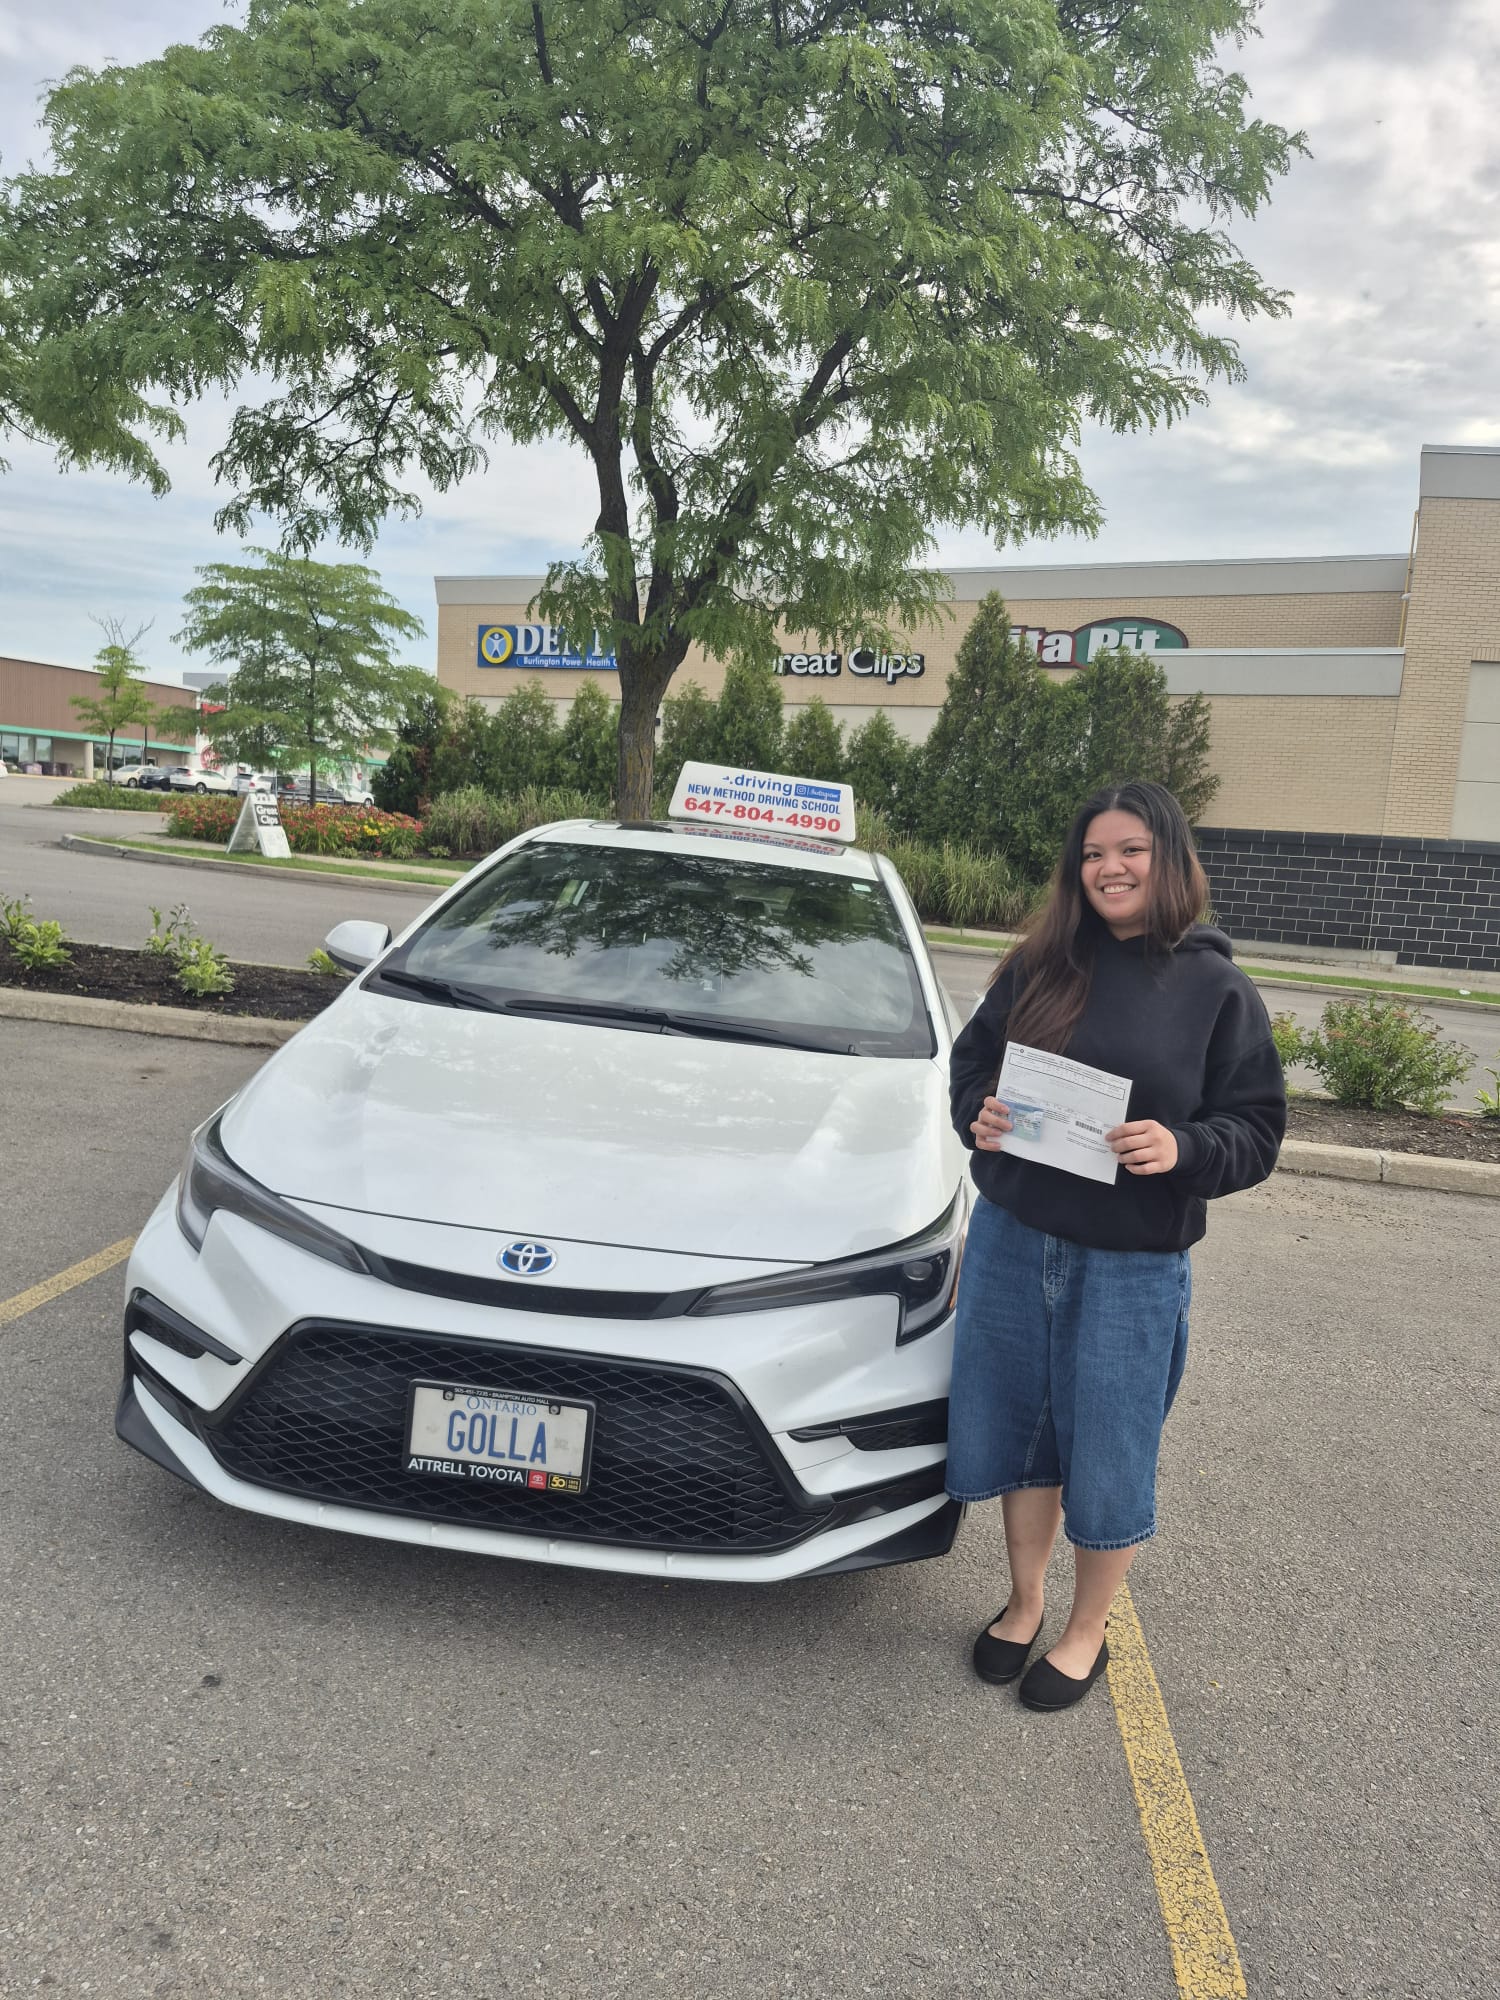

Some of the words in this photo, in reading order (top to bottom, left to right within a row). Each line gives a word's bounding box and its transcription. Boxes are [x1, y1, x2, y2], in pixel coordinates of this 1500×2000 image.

[523, 656, 561, 668] Burlington
[562, 657, 583, 667] Powe
[586, 658, 611, 668] Health
[1007, 628, 1073, 663] ita
[1087, 627, 1160, 663] Pit
[772, 651, 838, 674] reat
[848, 646, 922, 682] Clips
[684, 797, 841, 833] 647-804-4990
[688, 783, 712, 796] NEW
[713, 787, 756, 803] METHOD
[758, 793, 799, 810] DRIVING
[801, 800, 841, 815] SCHOOL
[466, 1395, 537, 1416] ONTARIO
[447, 1409, 547, 1465] GOLLA
[408, 1457, 466, 1477] ATTRELL
[468, 1464, 524, 1484] TOYOTA
[551, 1475, 566, 1488] 50
